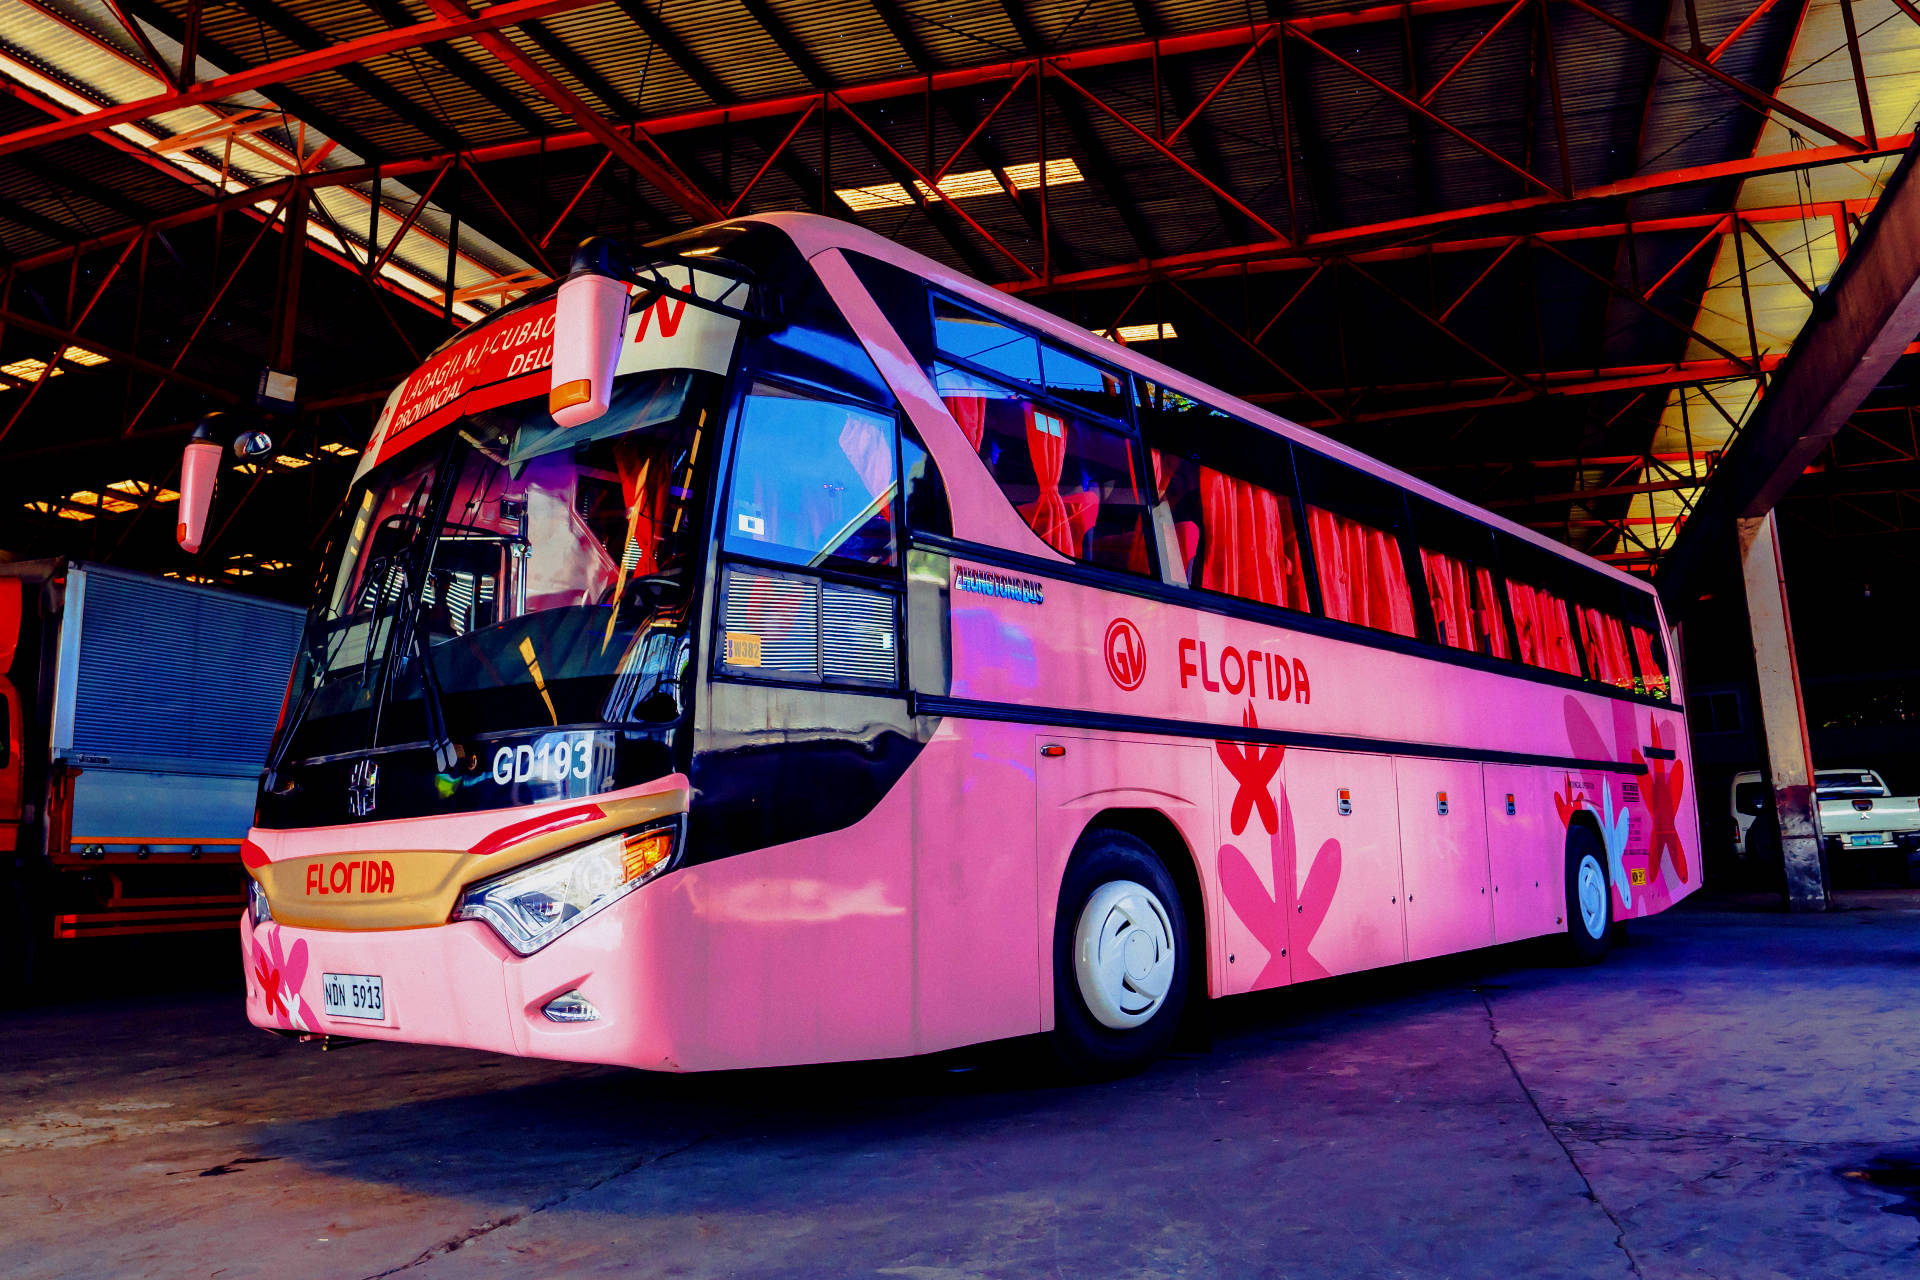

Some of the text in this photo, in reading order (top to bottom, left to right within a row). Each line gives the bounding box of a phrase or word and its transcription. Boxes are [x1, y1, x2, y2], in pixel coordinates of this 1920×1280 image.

[507, 345, 554, 378] DELU
[392, 378, 465, 435] PROVINCIAL
[493, 740, 593, 785] GD193
[325, 982, 382, 1010] NDN 5913
